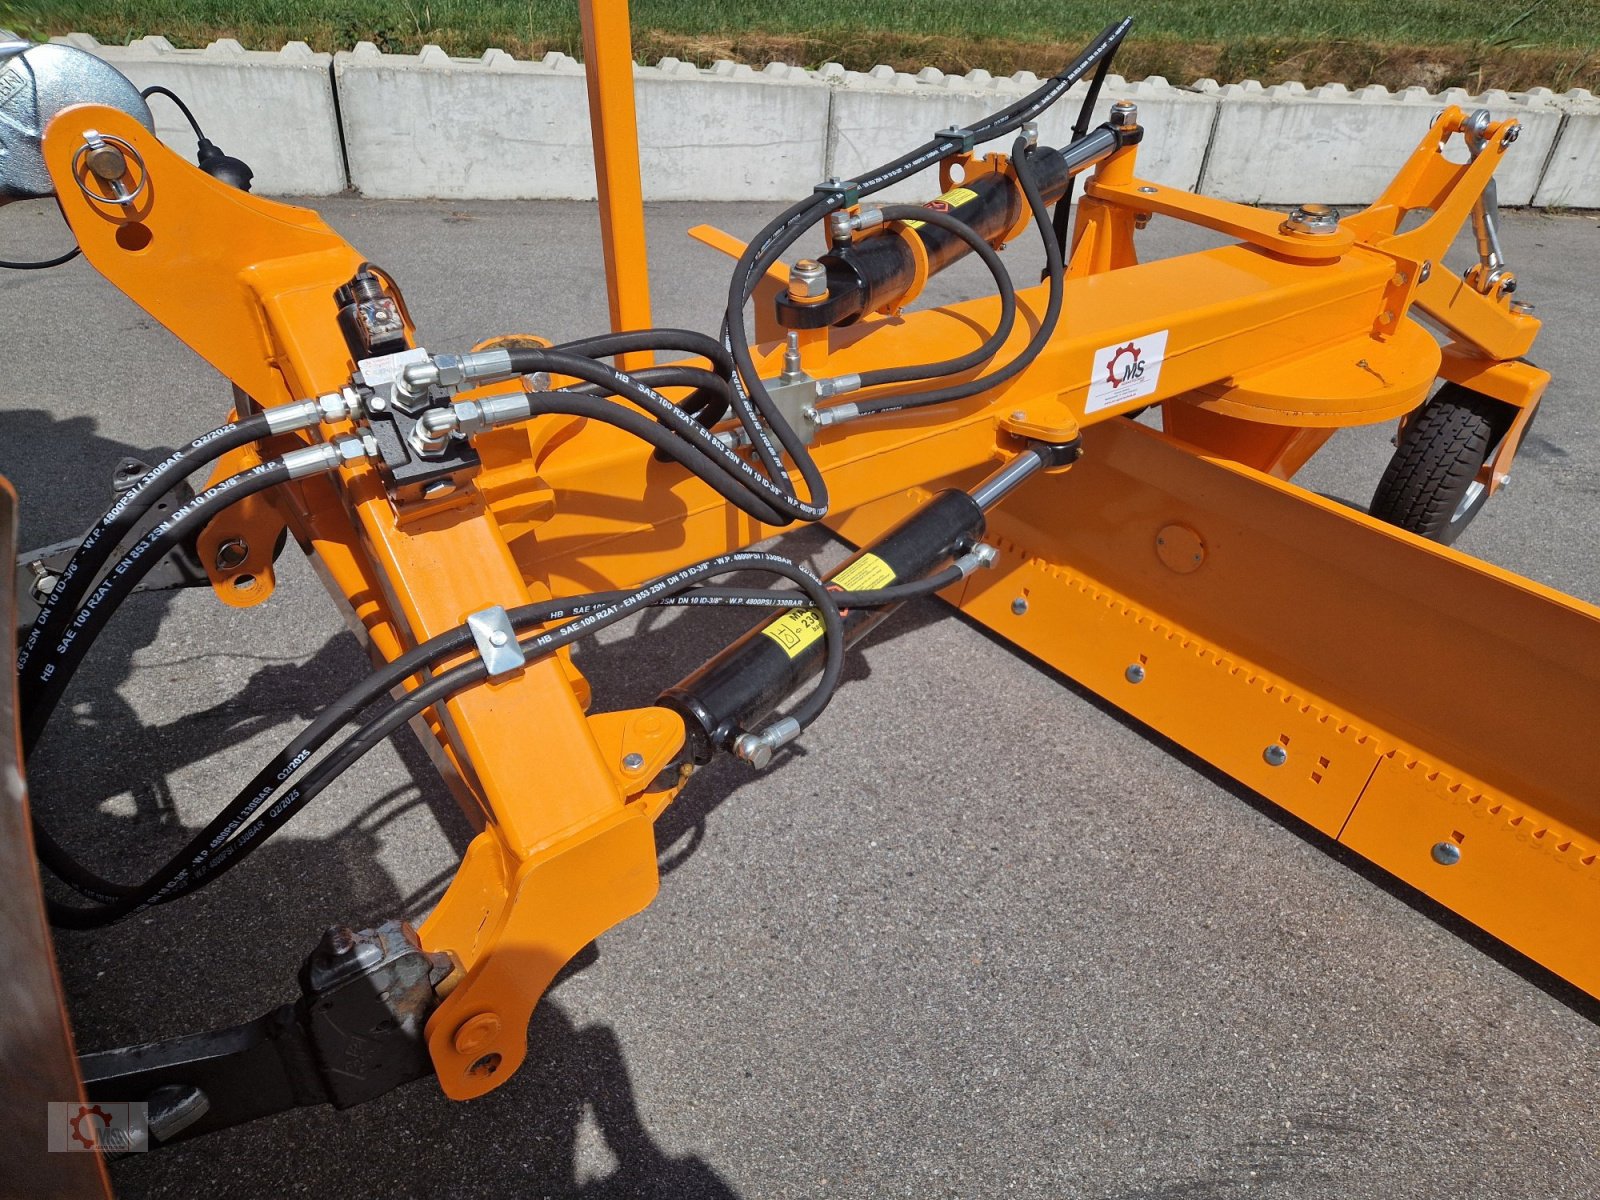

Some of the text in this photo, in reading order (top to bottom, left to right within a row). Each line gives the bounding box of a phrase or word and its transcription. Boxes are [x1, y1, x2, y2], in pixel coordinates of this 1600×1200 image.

[1122, 360, 1146, 382] MS
[614, 371, 630, 383] HB
[637, 383, 657, 400] SAE
[658, 396, 673, 410] 100
[673, 407, 696, 427] R2AT
[699, 427, 712, 441] EN
[711, 437, 725, 452] 853
[724, 449, 740, 465] 2SN
[741, 462, 753, 476] DN
[753, 472, 762, 482] 10
[25, 628, 41, 651] 2SN
[38, 607, 52, 625] DN
[48, 594, 59, 606] 10
[191, 423, 238, 449] Q2/2025
[40, 663, 55, 682] HB
[57, 629, 77, 654] SAE
[73, 609, 91, 628] 100
[87, 579, 113, 609] R2AT
[116, 557, 133, 576] EN
[130, 541, 150, 563] 853
[147, 521, 172, 542] 2SN
[171, 505, 191, 521] DN
[190, 496, 205, 507] 10
[537, 634, 553, 646] HB
[560, 624, 580, 637] SAE
[580, 615, 596, 627] 100
[596, 605, 619, 620] R2AT
[623, 596, 637, 607] EN
[635, 589, 650, 601] 853
[650, 581, 666, 594] 2SN
[667, 575, 680, 586] DN
[679, 571, 689, 580] 10
[550, 610, 564, 619] HB
[572, 605, 591, 615] SAE
[801, 612, 819, 628] 230
[277, 749, 311, 781] Q2/2025
[269, 788, 300, 818] Q2/2025
